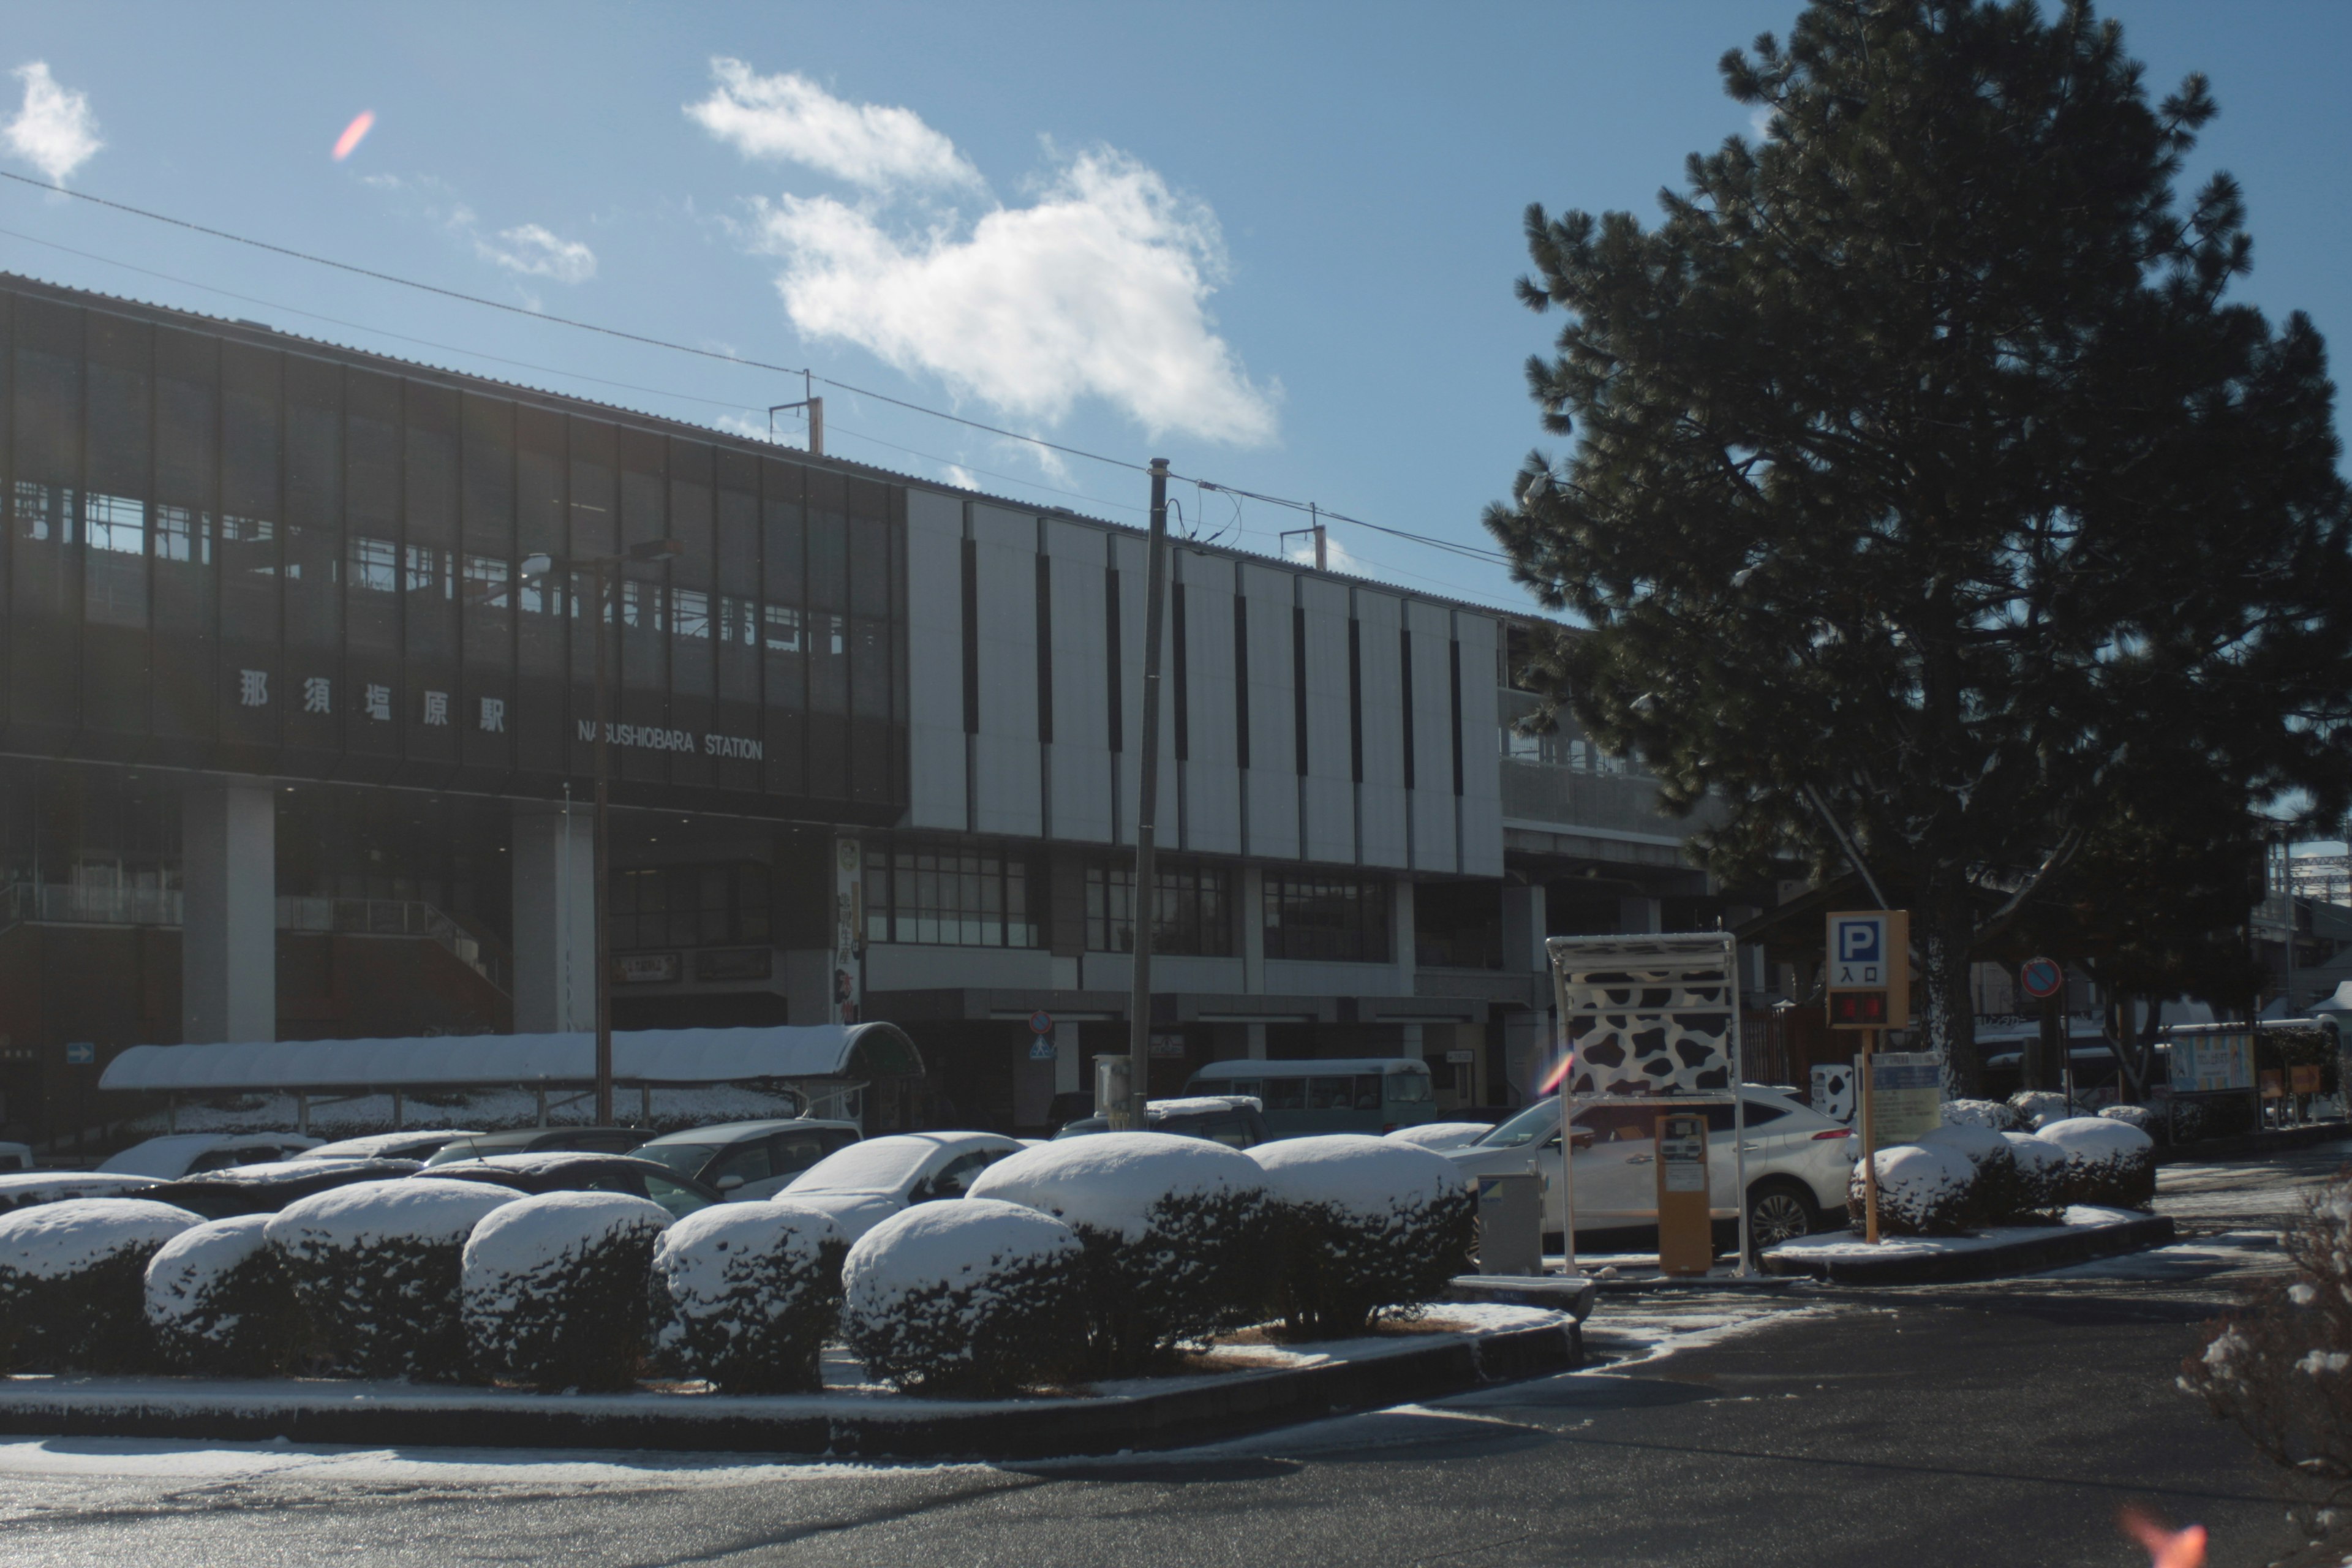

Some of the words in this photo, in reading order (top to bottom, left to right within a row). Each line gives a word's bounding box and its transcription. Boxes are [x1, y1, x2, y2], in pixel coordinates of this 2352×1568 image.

[239, 669, 505, 733] 那須塩原駅
[705, 734, 763, 760] STATION
[1844, 925, 1874, 959] P
[1841, 967, 1877, 982] 入口
